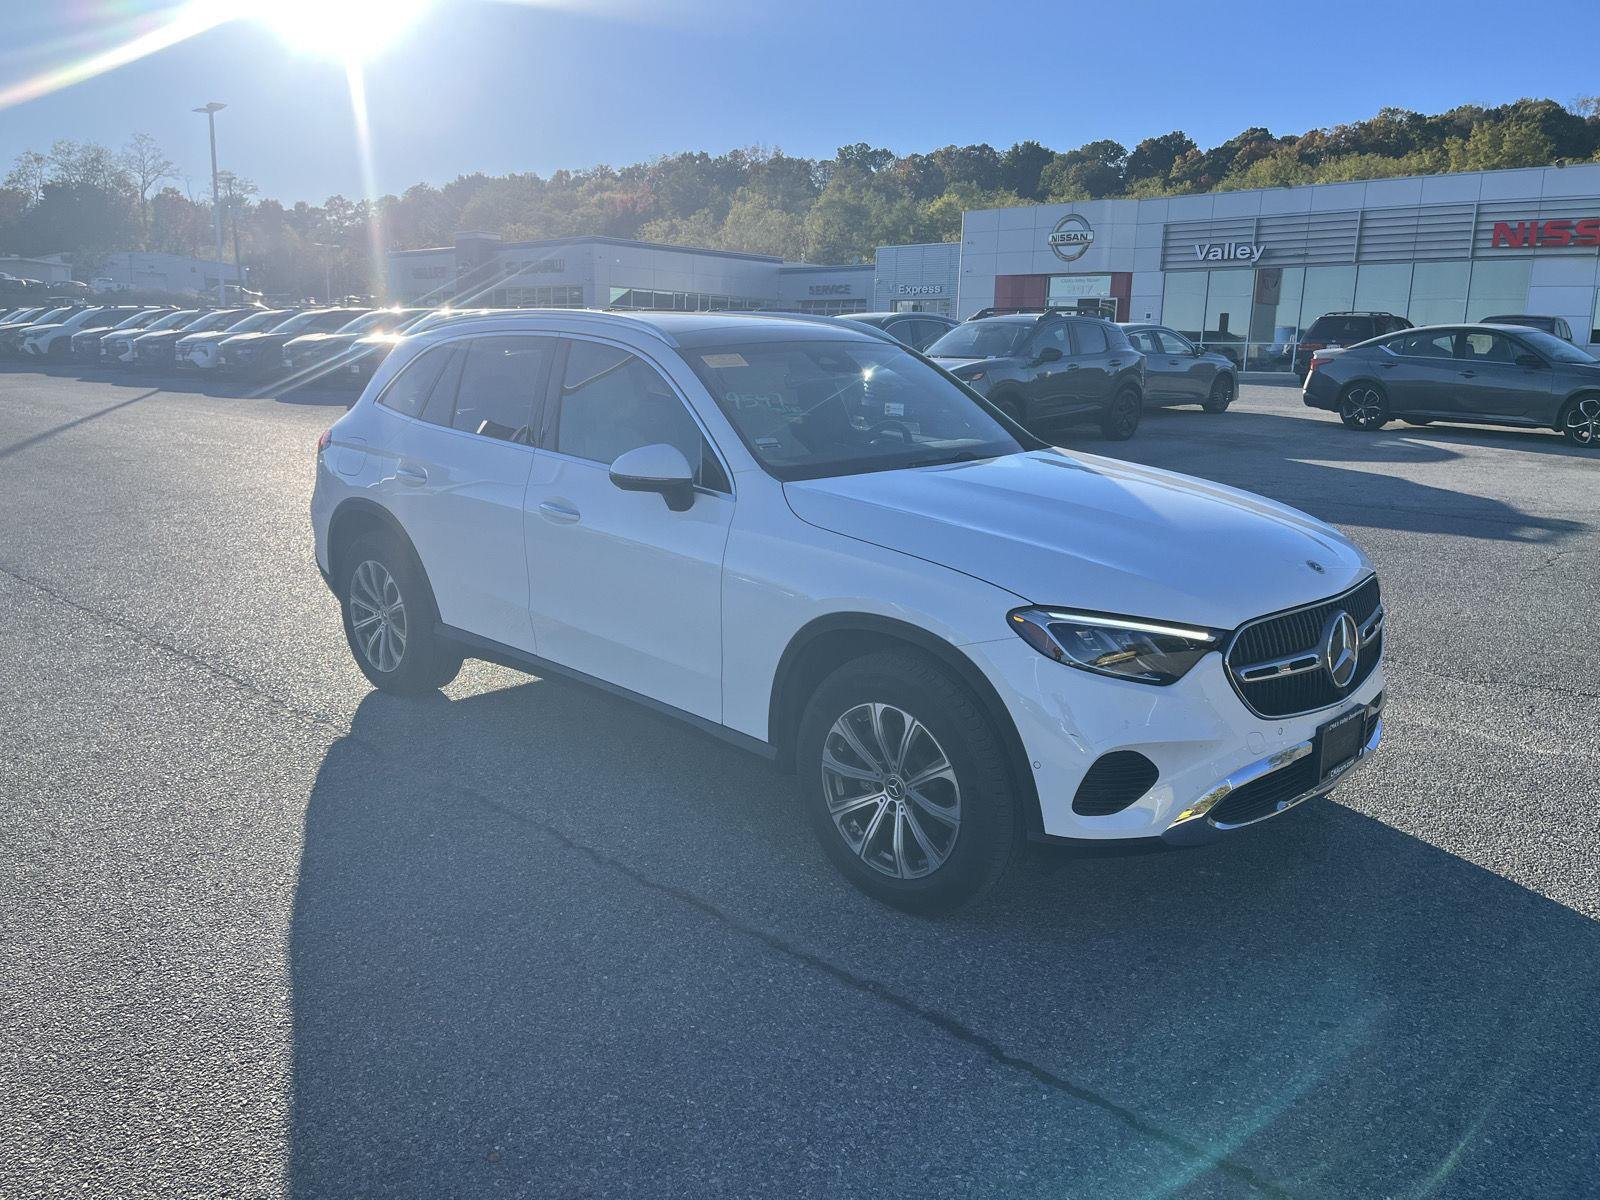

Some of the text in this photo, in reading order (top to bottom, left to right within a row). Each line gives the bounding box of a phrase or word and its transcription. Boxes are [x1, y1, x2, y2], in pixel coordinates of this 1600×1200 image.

[1051, 233, 1088, 243] NISSAN
[1491, 219, 1600, 249] NISS
[1194, 242, 1265, 264] Valley
[809, 284, 850, 295] SERVICE
[898, 284, 941, 296] Express
